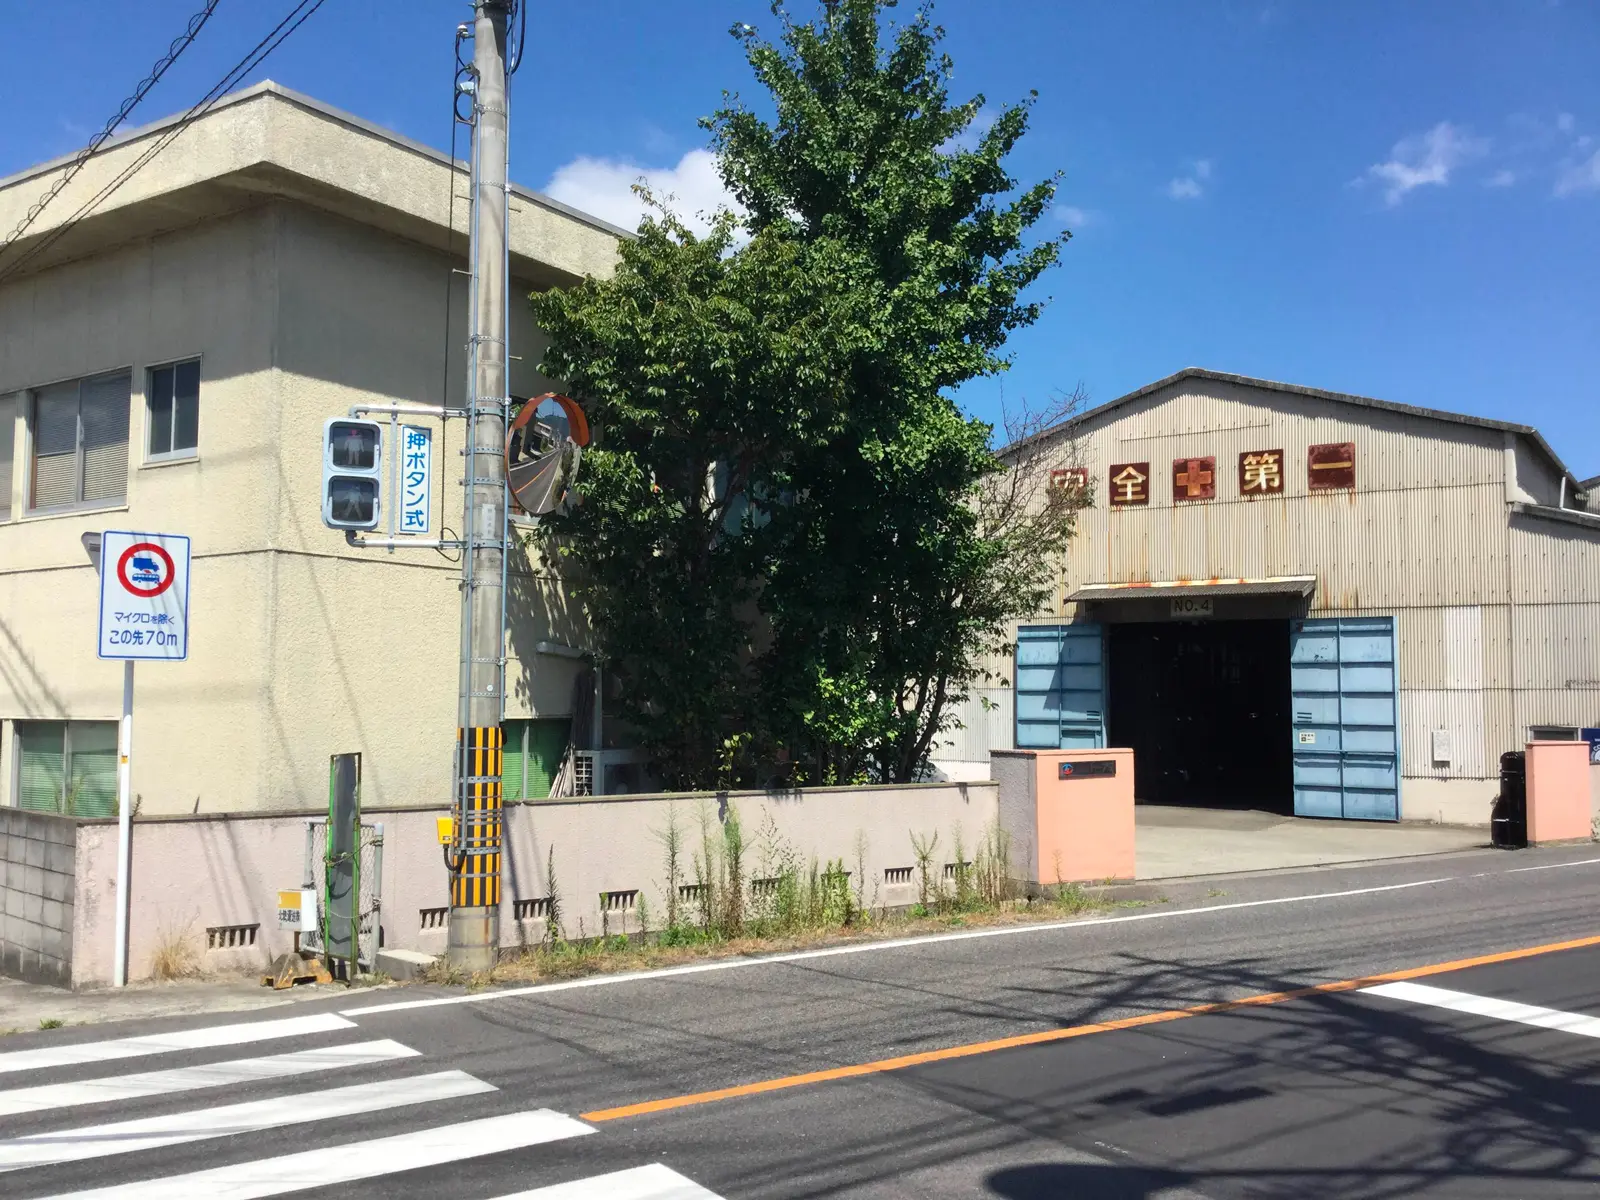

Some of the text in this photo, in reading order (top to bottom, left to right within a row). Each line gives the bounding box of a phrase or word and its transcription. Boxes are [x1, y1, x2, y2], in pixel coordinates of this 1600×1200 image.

[405, 432, 426, 528] 押ボタン式
[114, 612, 175, 625] マイクロを除く
[109, 630, 178, 646] この先70m
